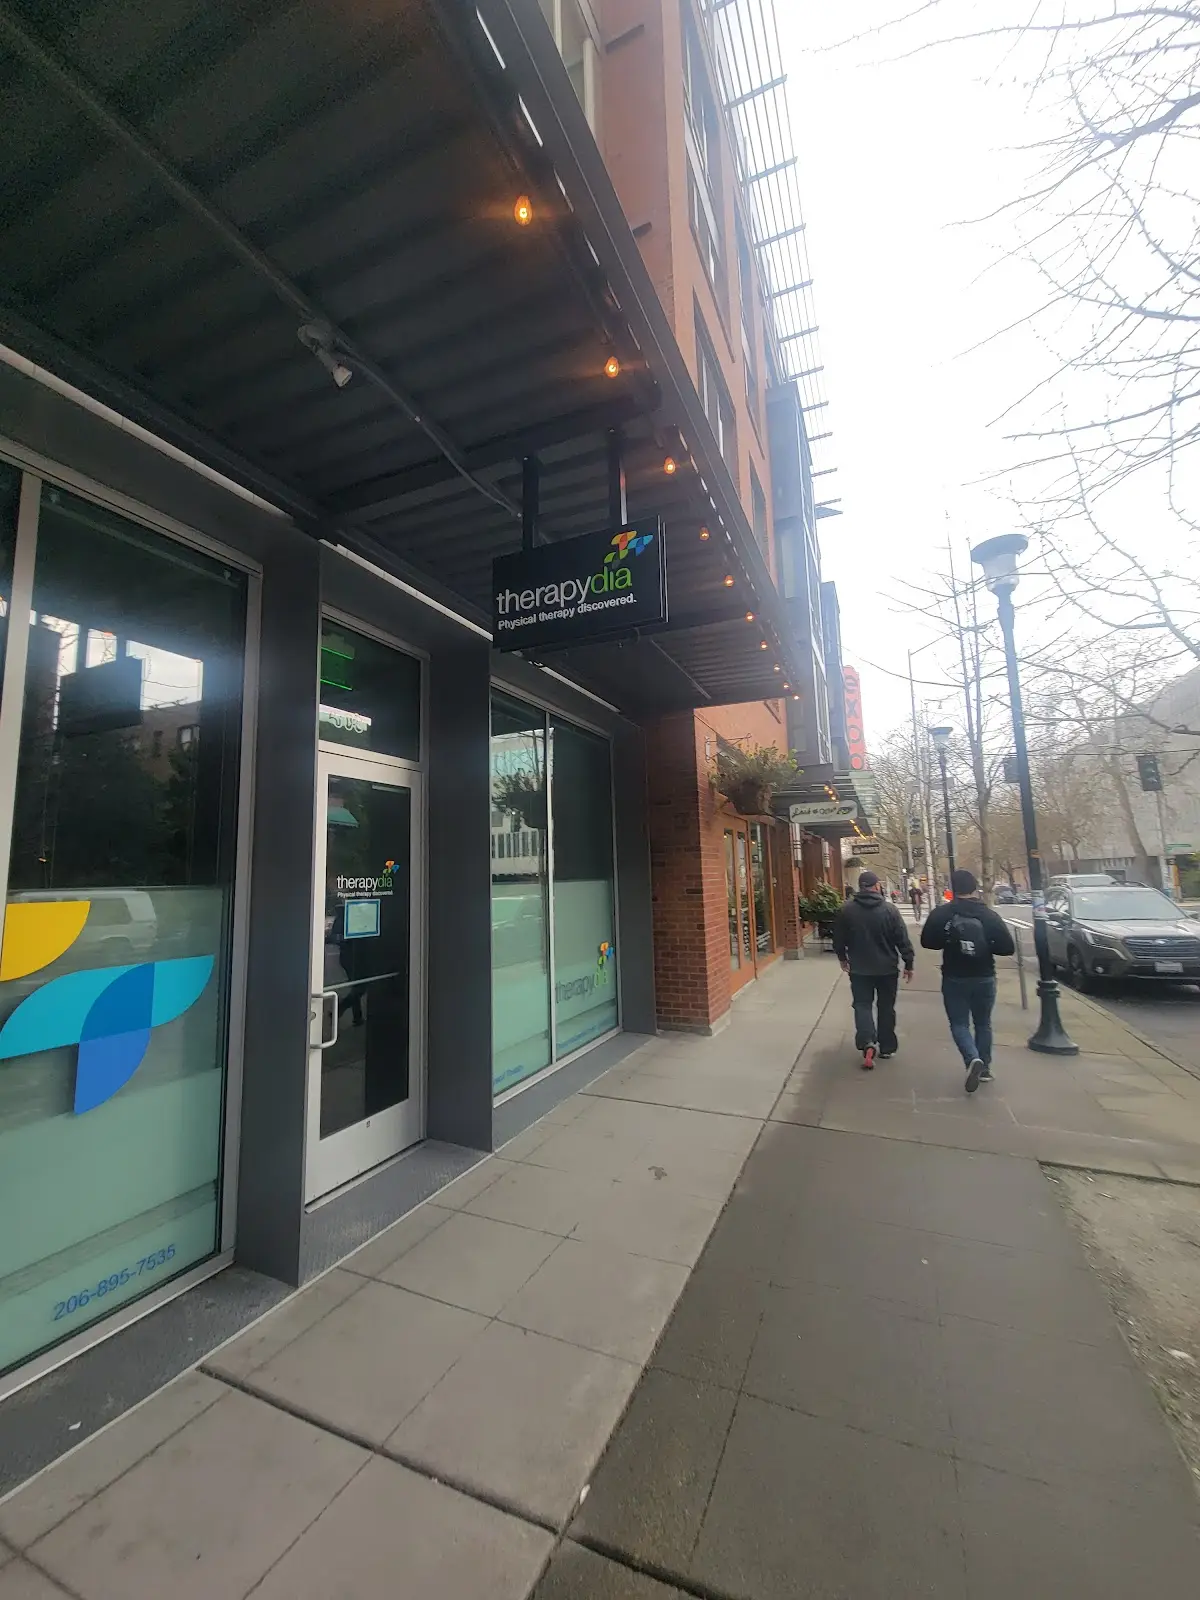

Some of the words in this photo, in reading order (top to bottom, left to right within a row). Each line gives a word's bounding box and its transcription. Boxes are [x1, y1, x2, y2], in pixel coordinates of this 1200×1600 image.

[496, 566, 632, 615] therapydia
[498, 614, 537, 631] Physical
[539, 606, 575, 623] therapy
[577, 593, 637, 615] discovered.
[336, 873, 393, 892] therapydia
[53, 1243, 177, 1322] 206-895-7535
